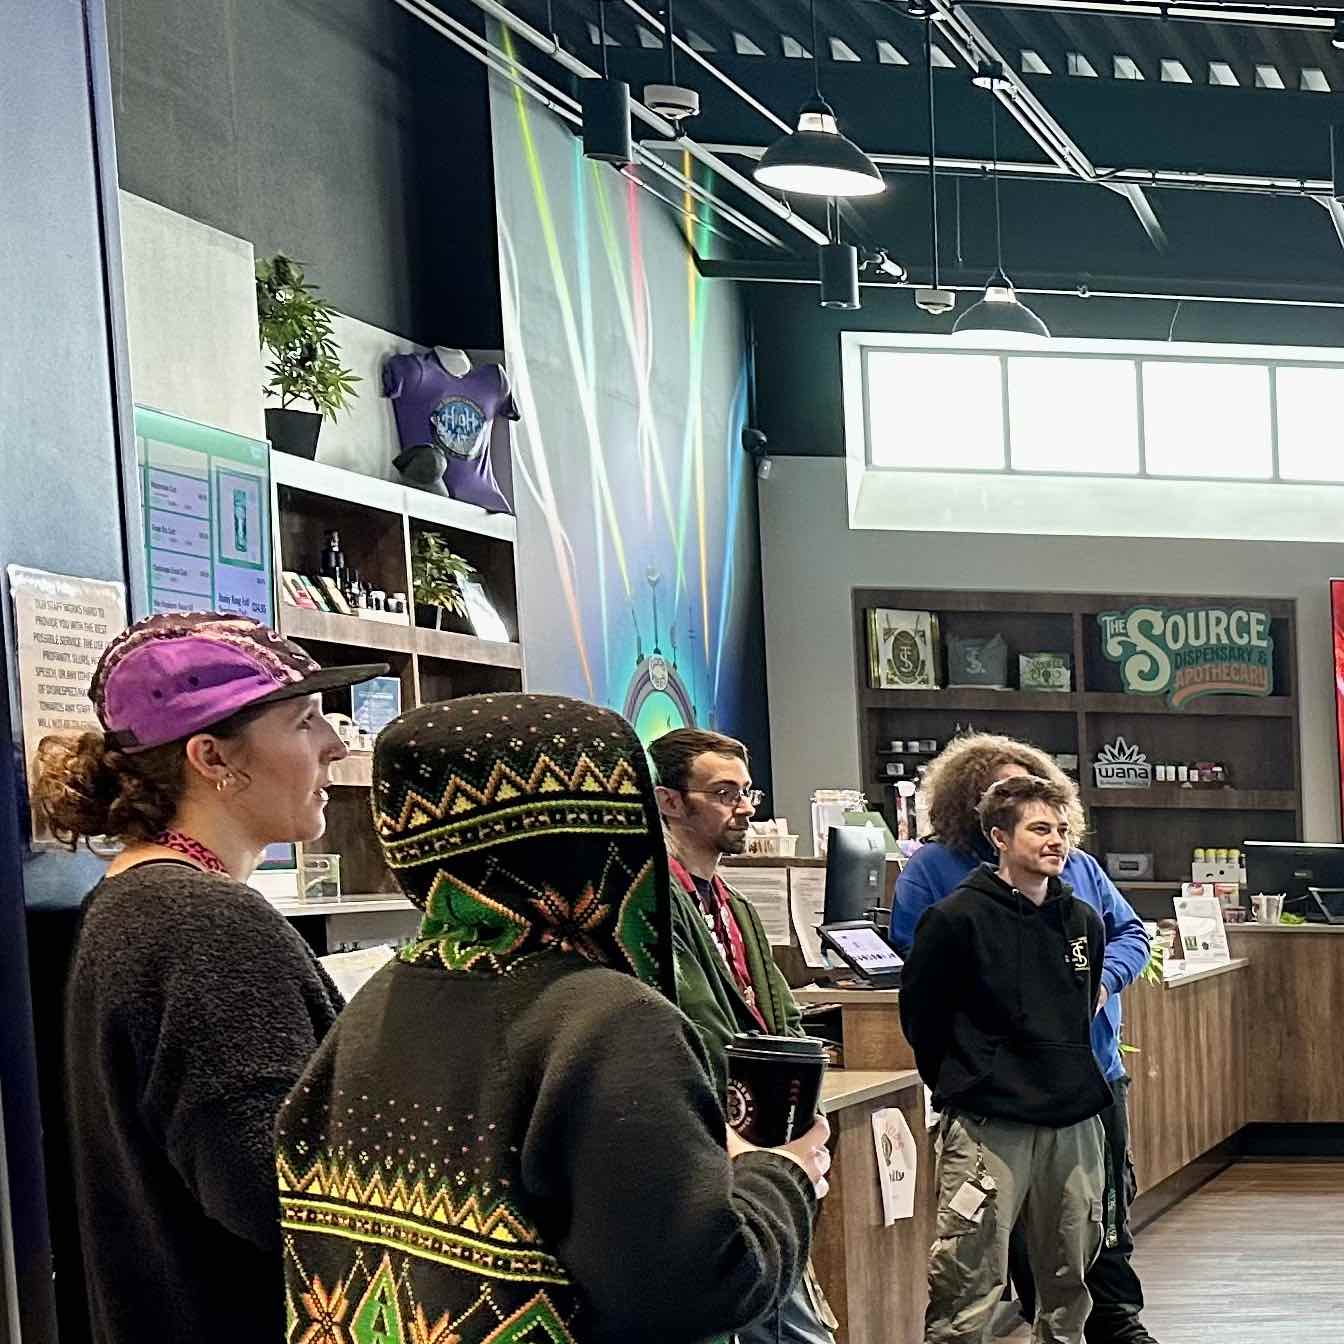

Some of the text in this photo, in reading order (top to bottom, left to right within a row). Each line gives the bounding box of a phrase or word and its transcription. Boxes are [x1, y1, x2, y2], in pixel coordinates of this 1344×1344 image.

[1102, 615, 1127, 641] THE
[1106, 608, 1268, 692] SOURCE
[1175, 648, 1252, 670] DISPENSARY
[1175, 663, 1269, 688] APOTHECARY
[1099, 768, 1149, 779] wana
